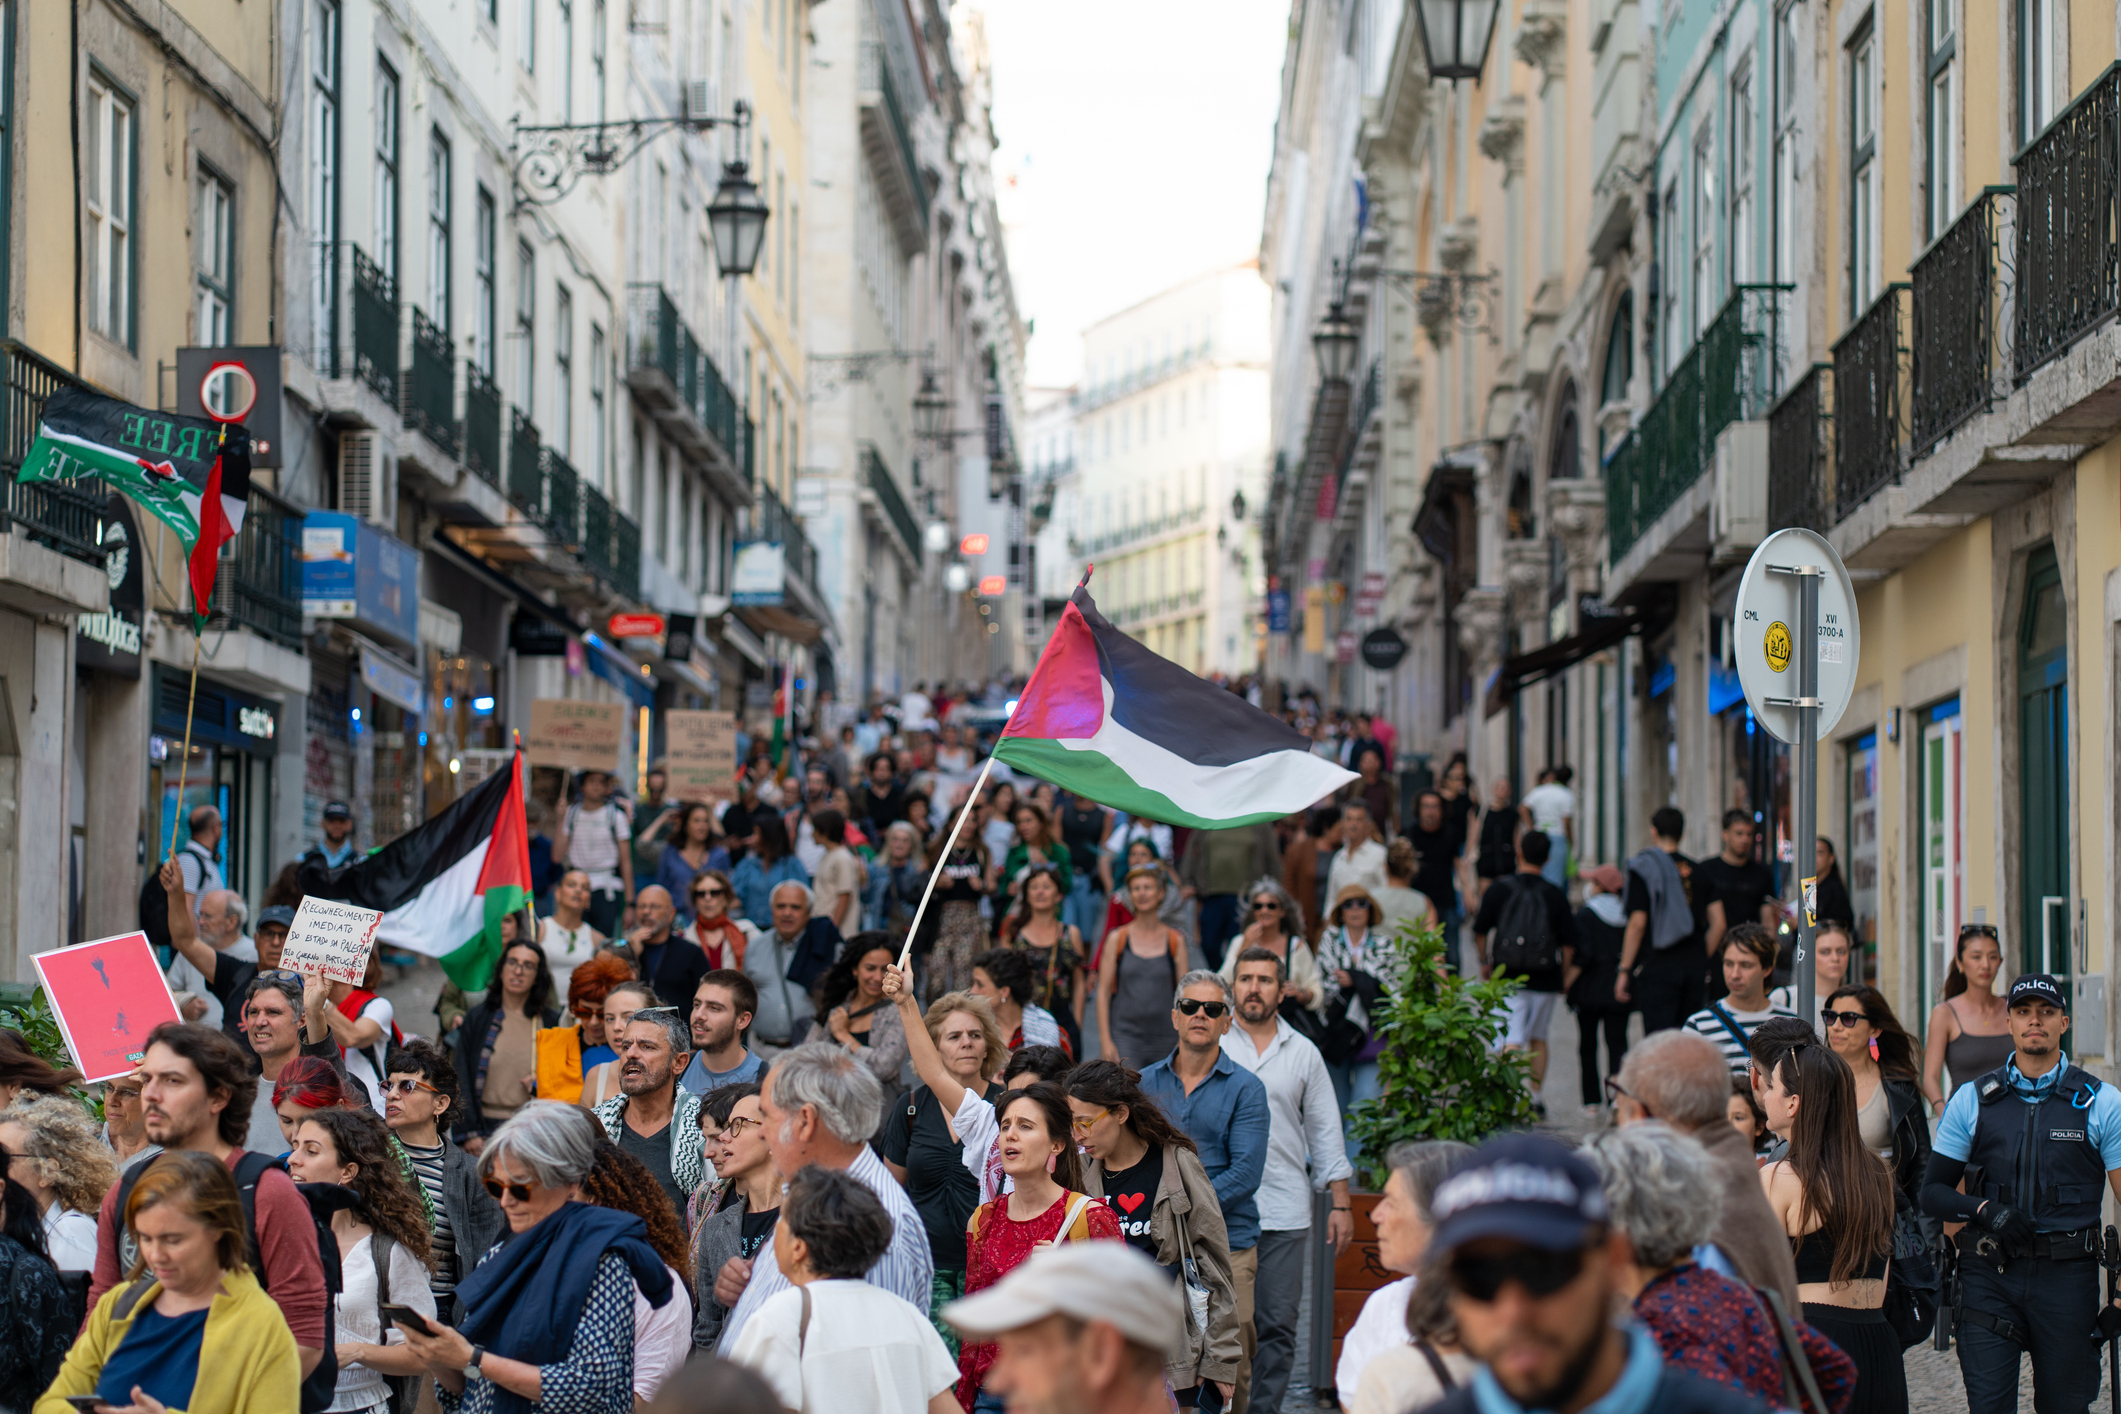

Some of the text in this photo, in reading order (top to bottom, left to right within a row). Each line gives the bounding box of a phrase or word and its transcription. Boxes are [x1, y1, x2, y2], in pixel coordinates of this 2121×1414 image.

[1744, 609, 1759, 621] CML
[1825, 613, 1837, 624] XVI
[1818, 626, 1844, 638] 3700-A
[2012, 979, 2057, 995] POLÍCIA
[102, 1048, 119, 1057] THIS
[128, 1051, 145, 1061] GAZA
[2051, 1131, 2082, 1139] POLÍCIA
